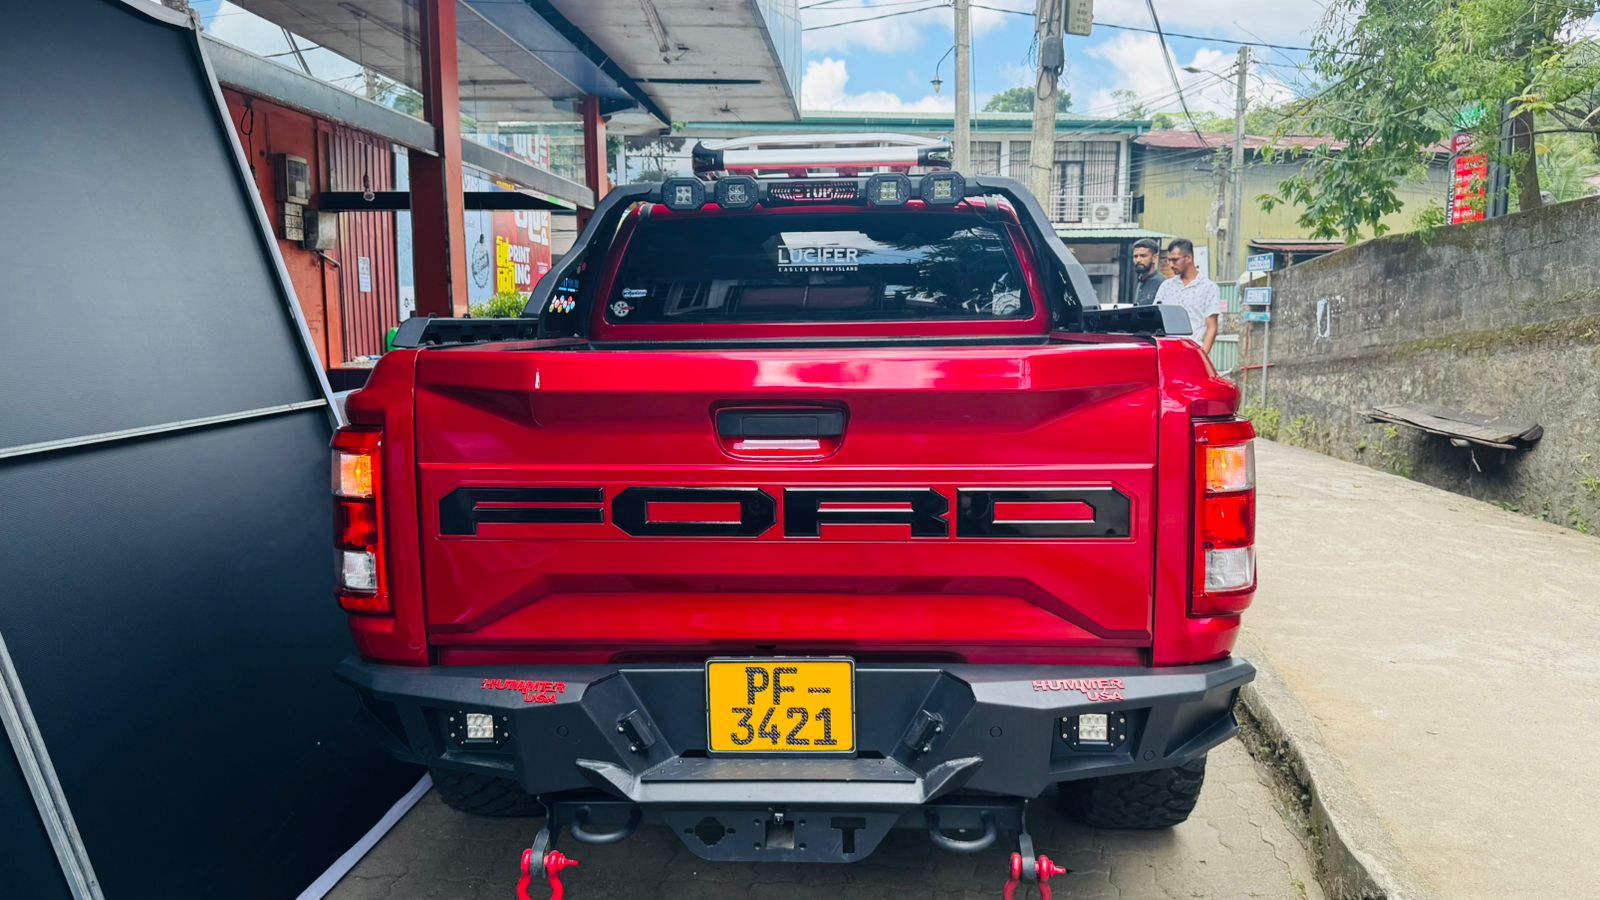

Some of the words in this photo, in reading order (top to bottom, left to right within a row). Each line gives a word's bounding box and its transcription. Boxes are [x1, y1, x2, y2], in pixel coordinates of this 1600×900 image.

[508, 244, 531, 264] PRINT
[778, 248, 859, 264] LUCIFER
[514, 262, 531, 285] ING
[440, 487, 1131, 539] FORD
[480, 678, 566, 693] HUMMER
[1032, 678, 1125, 692] HUMMER
[524, 692, 557, 703] USA
[1087, 690, 1125, 702] USA
[730, 707, 838, 745] 3421
